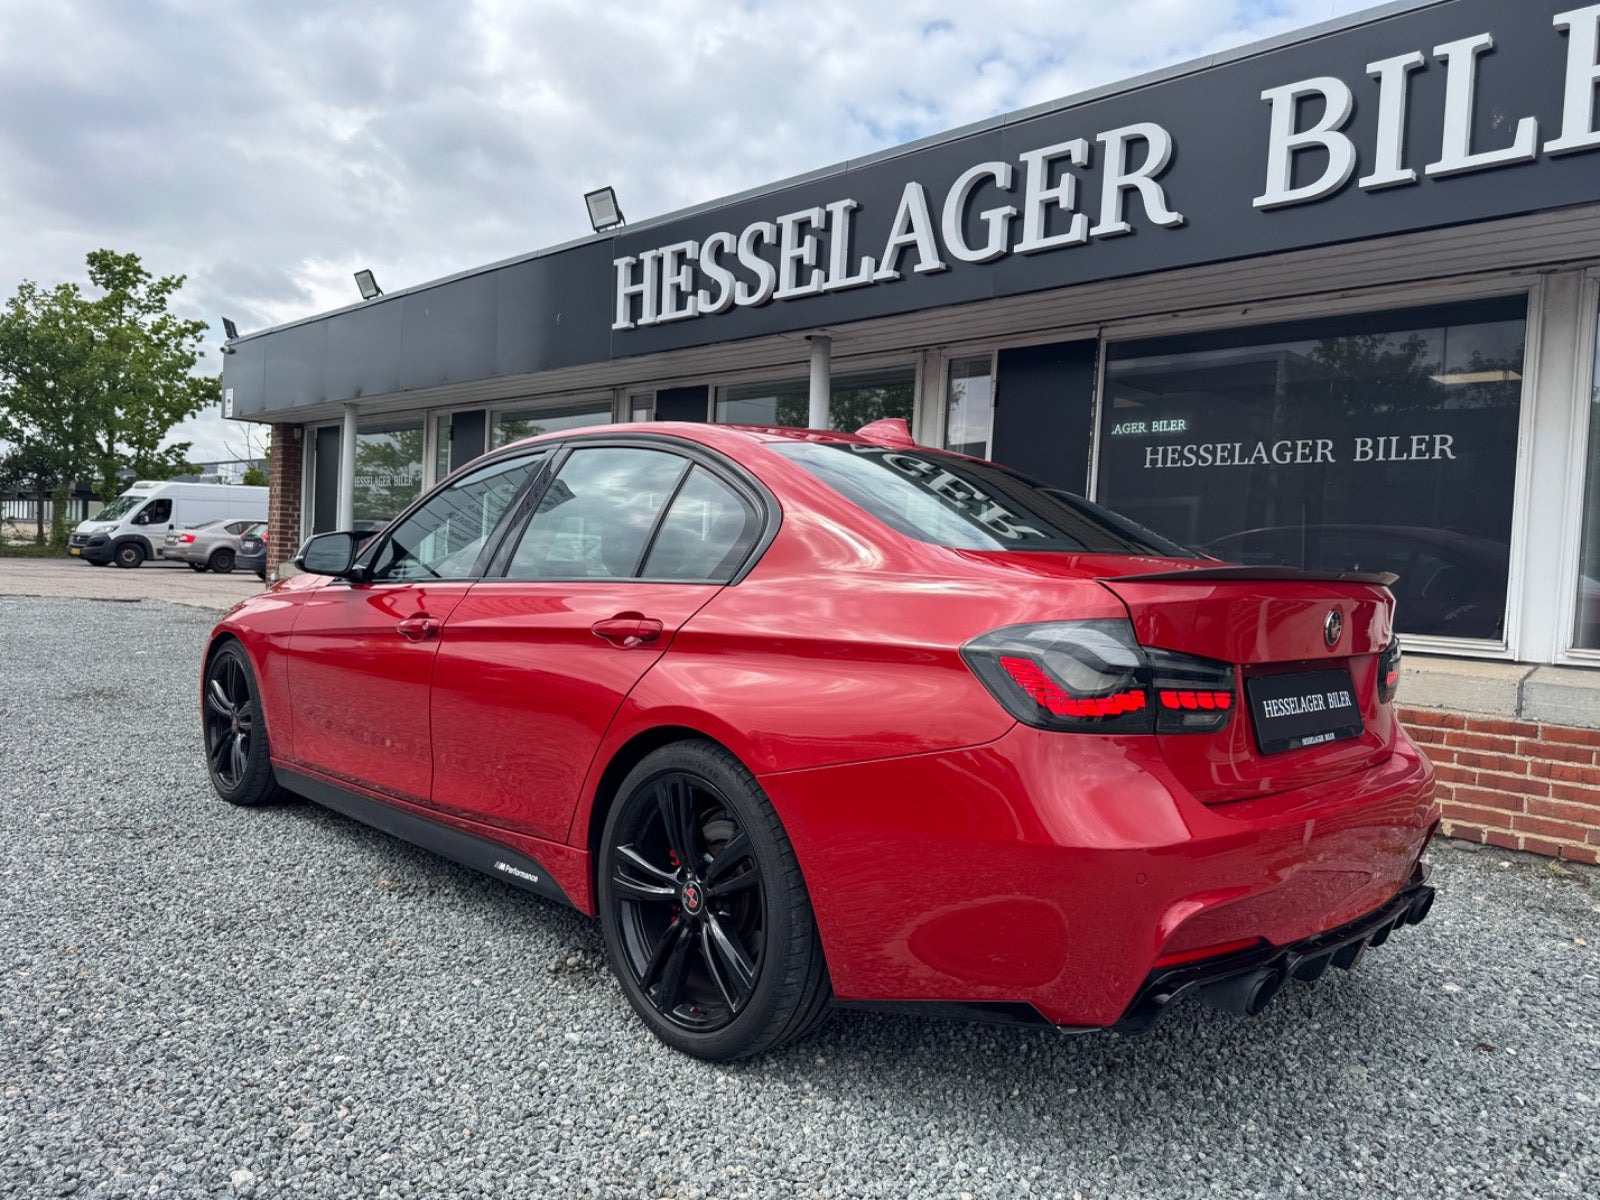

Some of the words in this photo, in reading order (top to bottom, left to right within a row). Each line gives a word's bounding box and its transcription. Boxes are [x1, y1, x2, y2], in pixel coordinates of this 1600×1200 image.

[612, 122, 1184, 330] HESSELAGER
[1111, 421, 1147, 435] AGER
[1152, 419, 1187, 433] BILER
[1143, 439, 1336, 469] HESSELAGER
[1353, 434, 1457, 462] BILER
[393, 475, 413, 487] BILER
[1263, 695, 1326, 718] HESSELAGER
[1327, 691, 1352, 709] BILER
